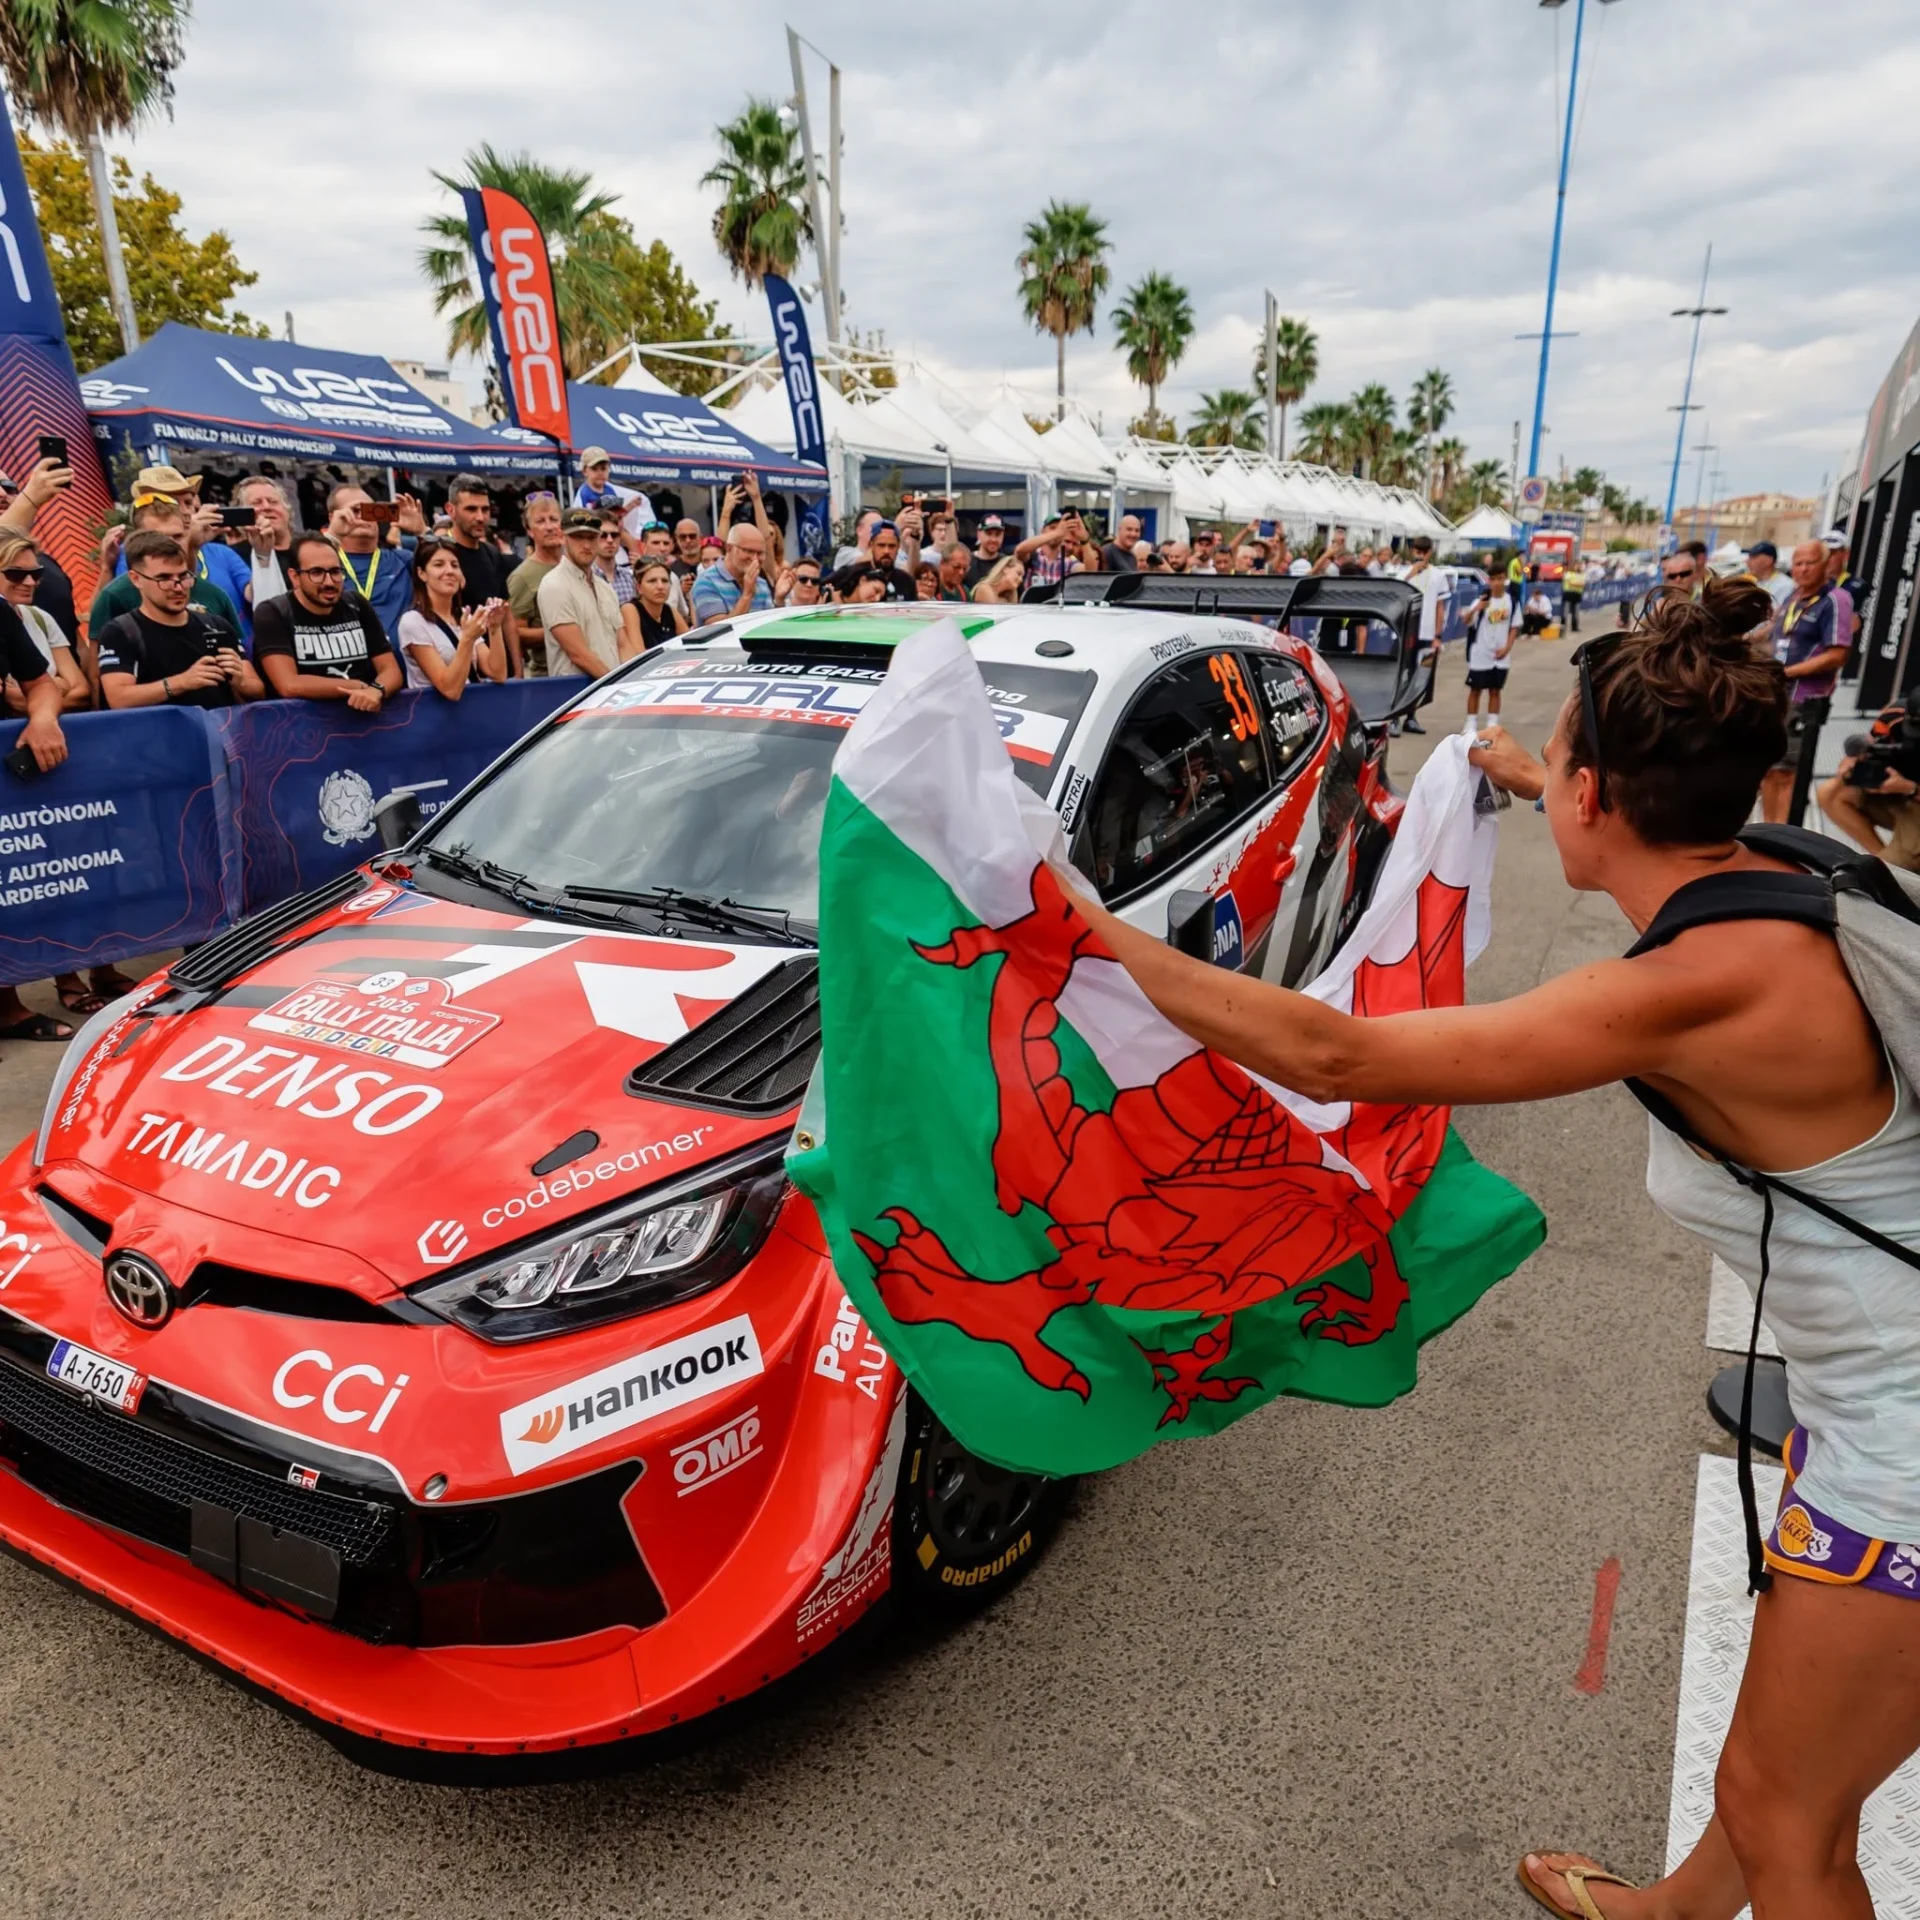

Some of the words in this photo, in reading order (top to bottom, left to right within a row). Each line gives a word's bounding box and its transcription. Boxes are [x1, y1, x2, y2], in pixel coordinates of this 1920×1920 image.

[215, 357, 432, 414] WRC
[152, 422, 176, 439] FIA
[176, 425, 219, 443] WORLD
[220, 430, 256, 448] RALLY
[257, 434, 337, 456] CHAMPIONSHIP
[354, 446, 396, 462] OFFICIAL
[396, 449, 457, 466] MERCHANDISE
[294, 628, 368, 661] PUMA
[1149, 633, 1197, 662] PROTERIAL
[700, 662, 801, 675] TOYOTA
[1208, 651, 1259, 742] 33
[1263, 679, 1300, 707] E.Evans
[0, 800, 118, 832] AUTÒNOMA
[8, 848, 125, 884] AUTONOMA
[371, 977, 396, 988] 33
[367, 995, 421, 1014] 2026
[276, 995, 373, 1028] RALLY
[359, 1014, 465, 1052] ITALIA
[284, 1022, 402, 1058] SARDEGNA
[161, 1035, 444, 1136] DENSO
[125, 1113, 342, 1208] TAMADIC
[481, 1129, 708, 1228] codebeamer
[63, 1353, 125, 1400] A-7650
[130, 1374, 144, 1391] 11
[123, 1393, 137, 1410] 26
[672, 1418, 762, 1484] OMP
[290, 1472, 316, 1489] GR
[1783, 1518, 1828, 1556] AKERS
[797, 1609, 840, 1643] BRAKE
[846, 1560, 892, 1607] EXPERTS
